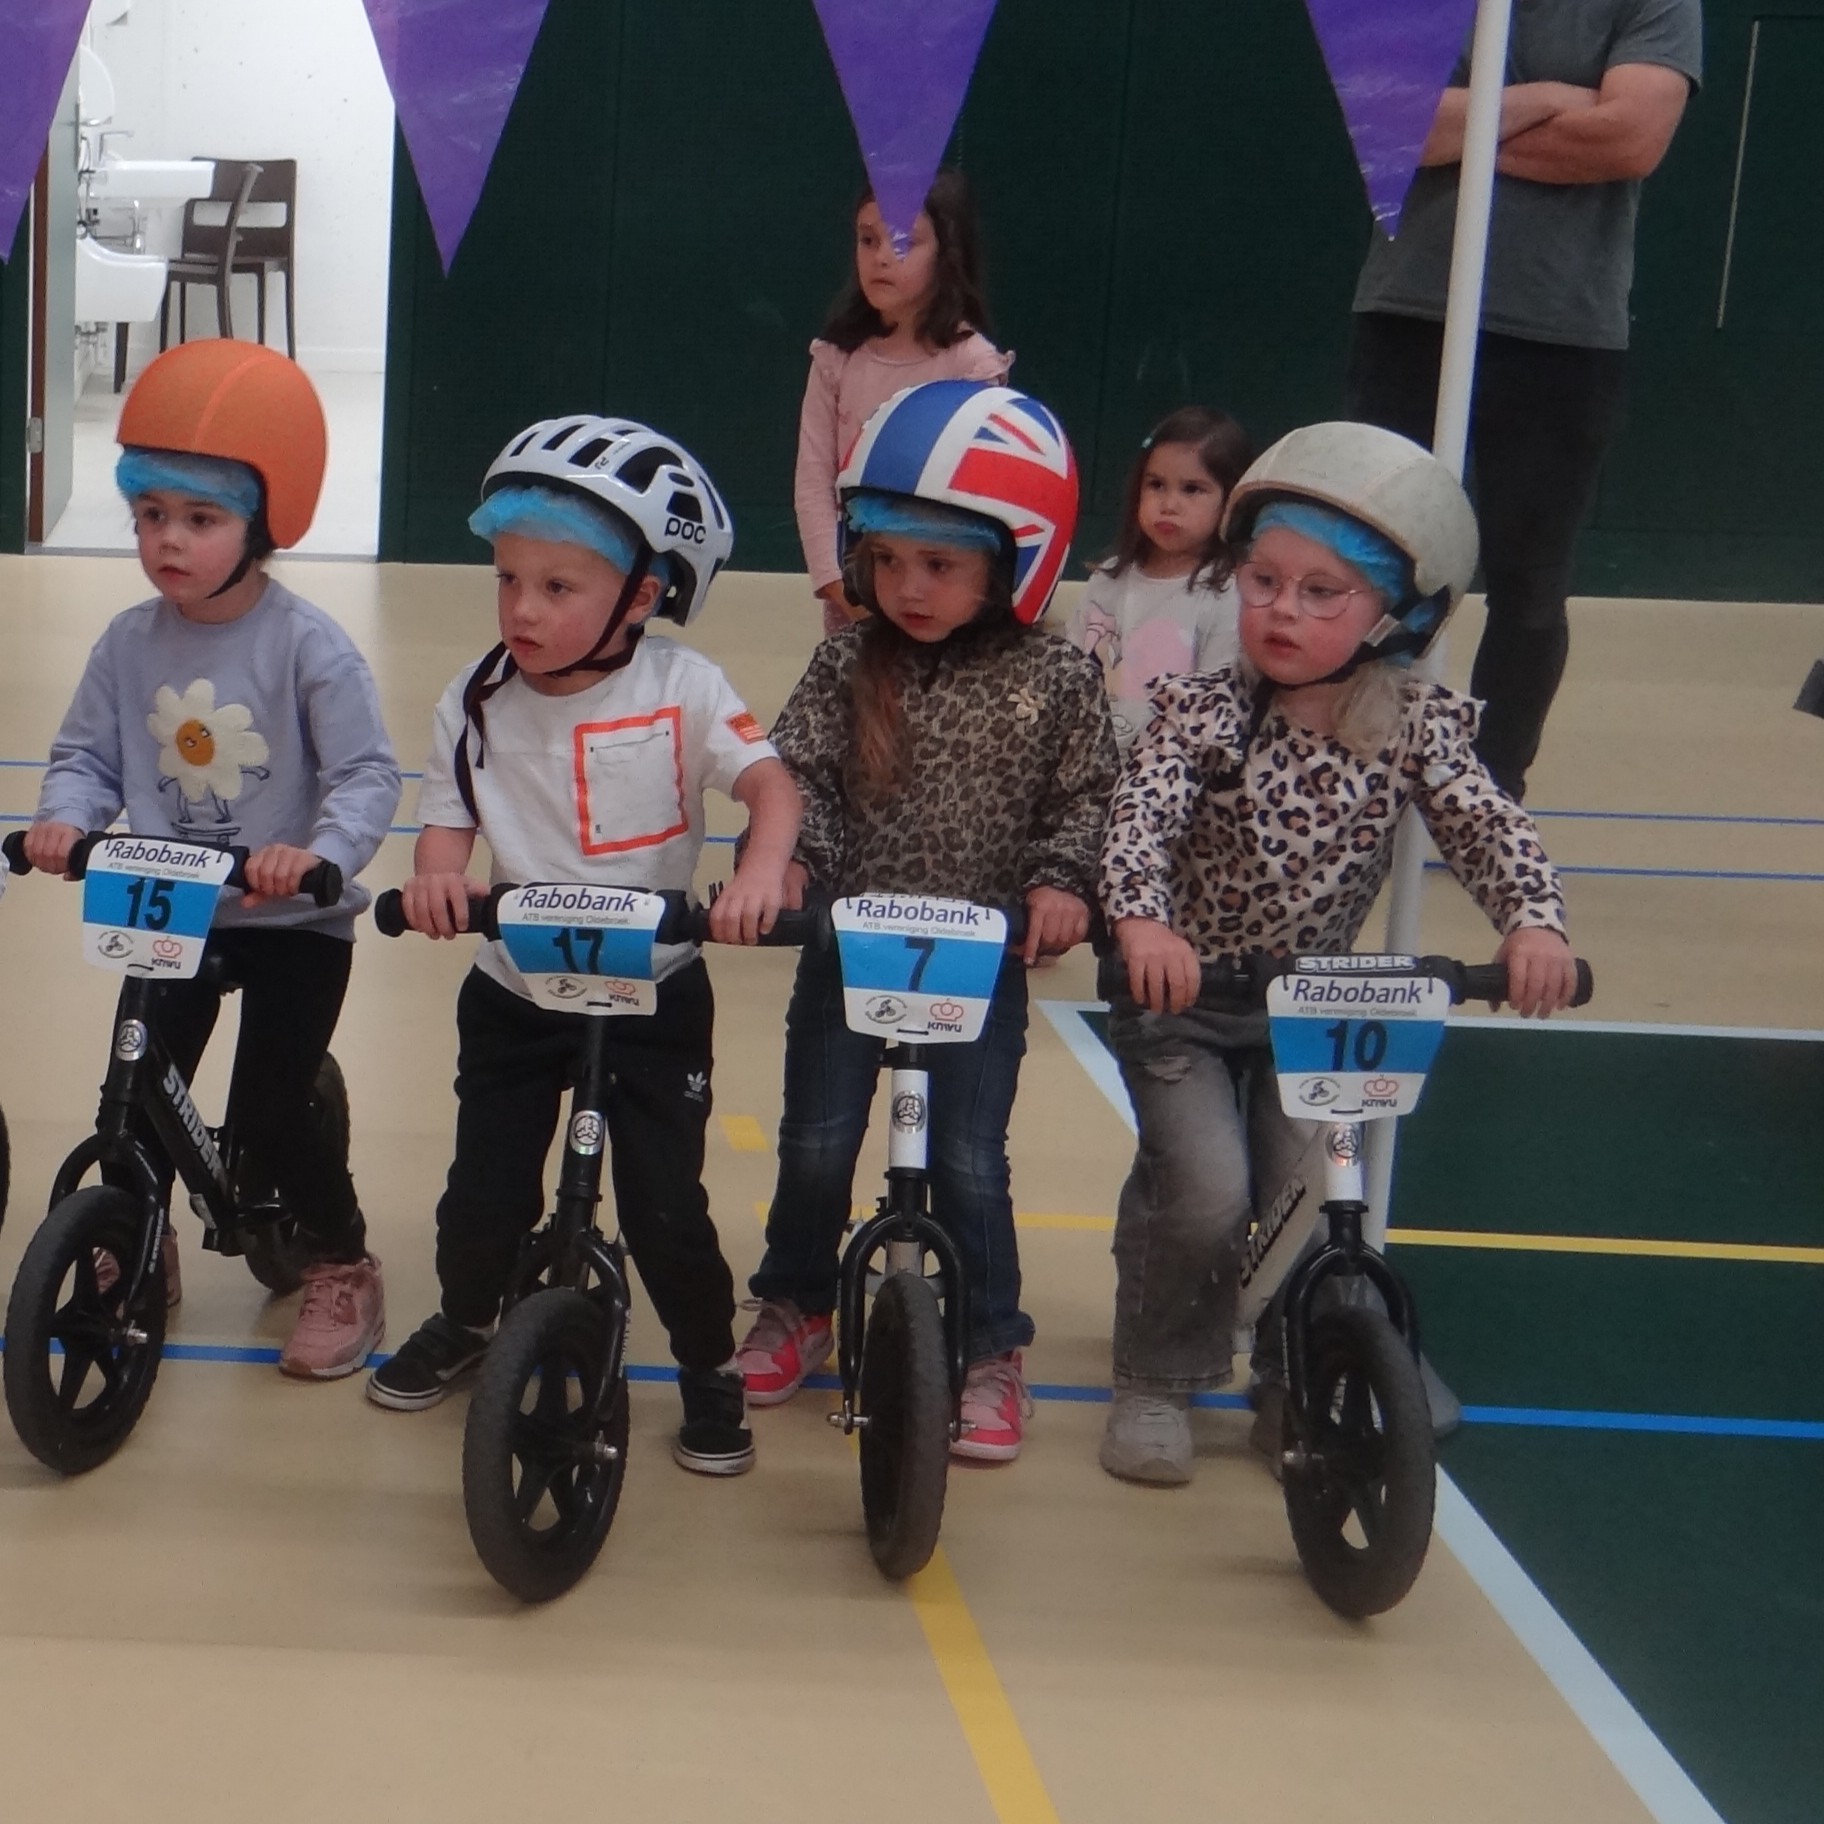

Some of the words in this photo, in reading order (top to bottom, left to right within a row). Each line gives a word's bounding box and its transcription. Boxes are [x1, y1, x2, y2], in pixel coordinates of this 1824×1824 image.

[107, 840, 211, 868] Rabobank
[127, 877, 175, 930] 15
[518, 887, 638, 912] Rabobank
[856, 899, 979, 926] Rabobank
[863, 921, 880, 930] ATB
[552, 927, 604, 975] 17
[904, 936, 936, 993] 7
[1298, 955, 1414, 971] STRIDER
[1293, 978, 1422, 1004] Rabobank
[1326, 1020, 1387, 1071] 10
[162, 1063, 222, 1180] STRIDER
